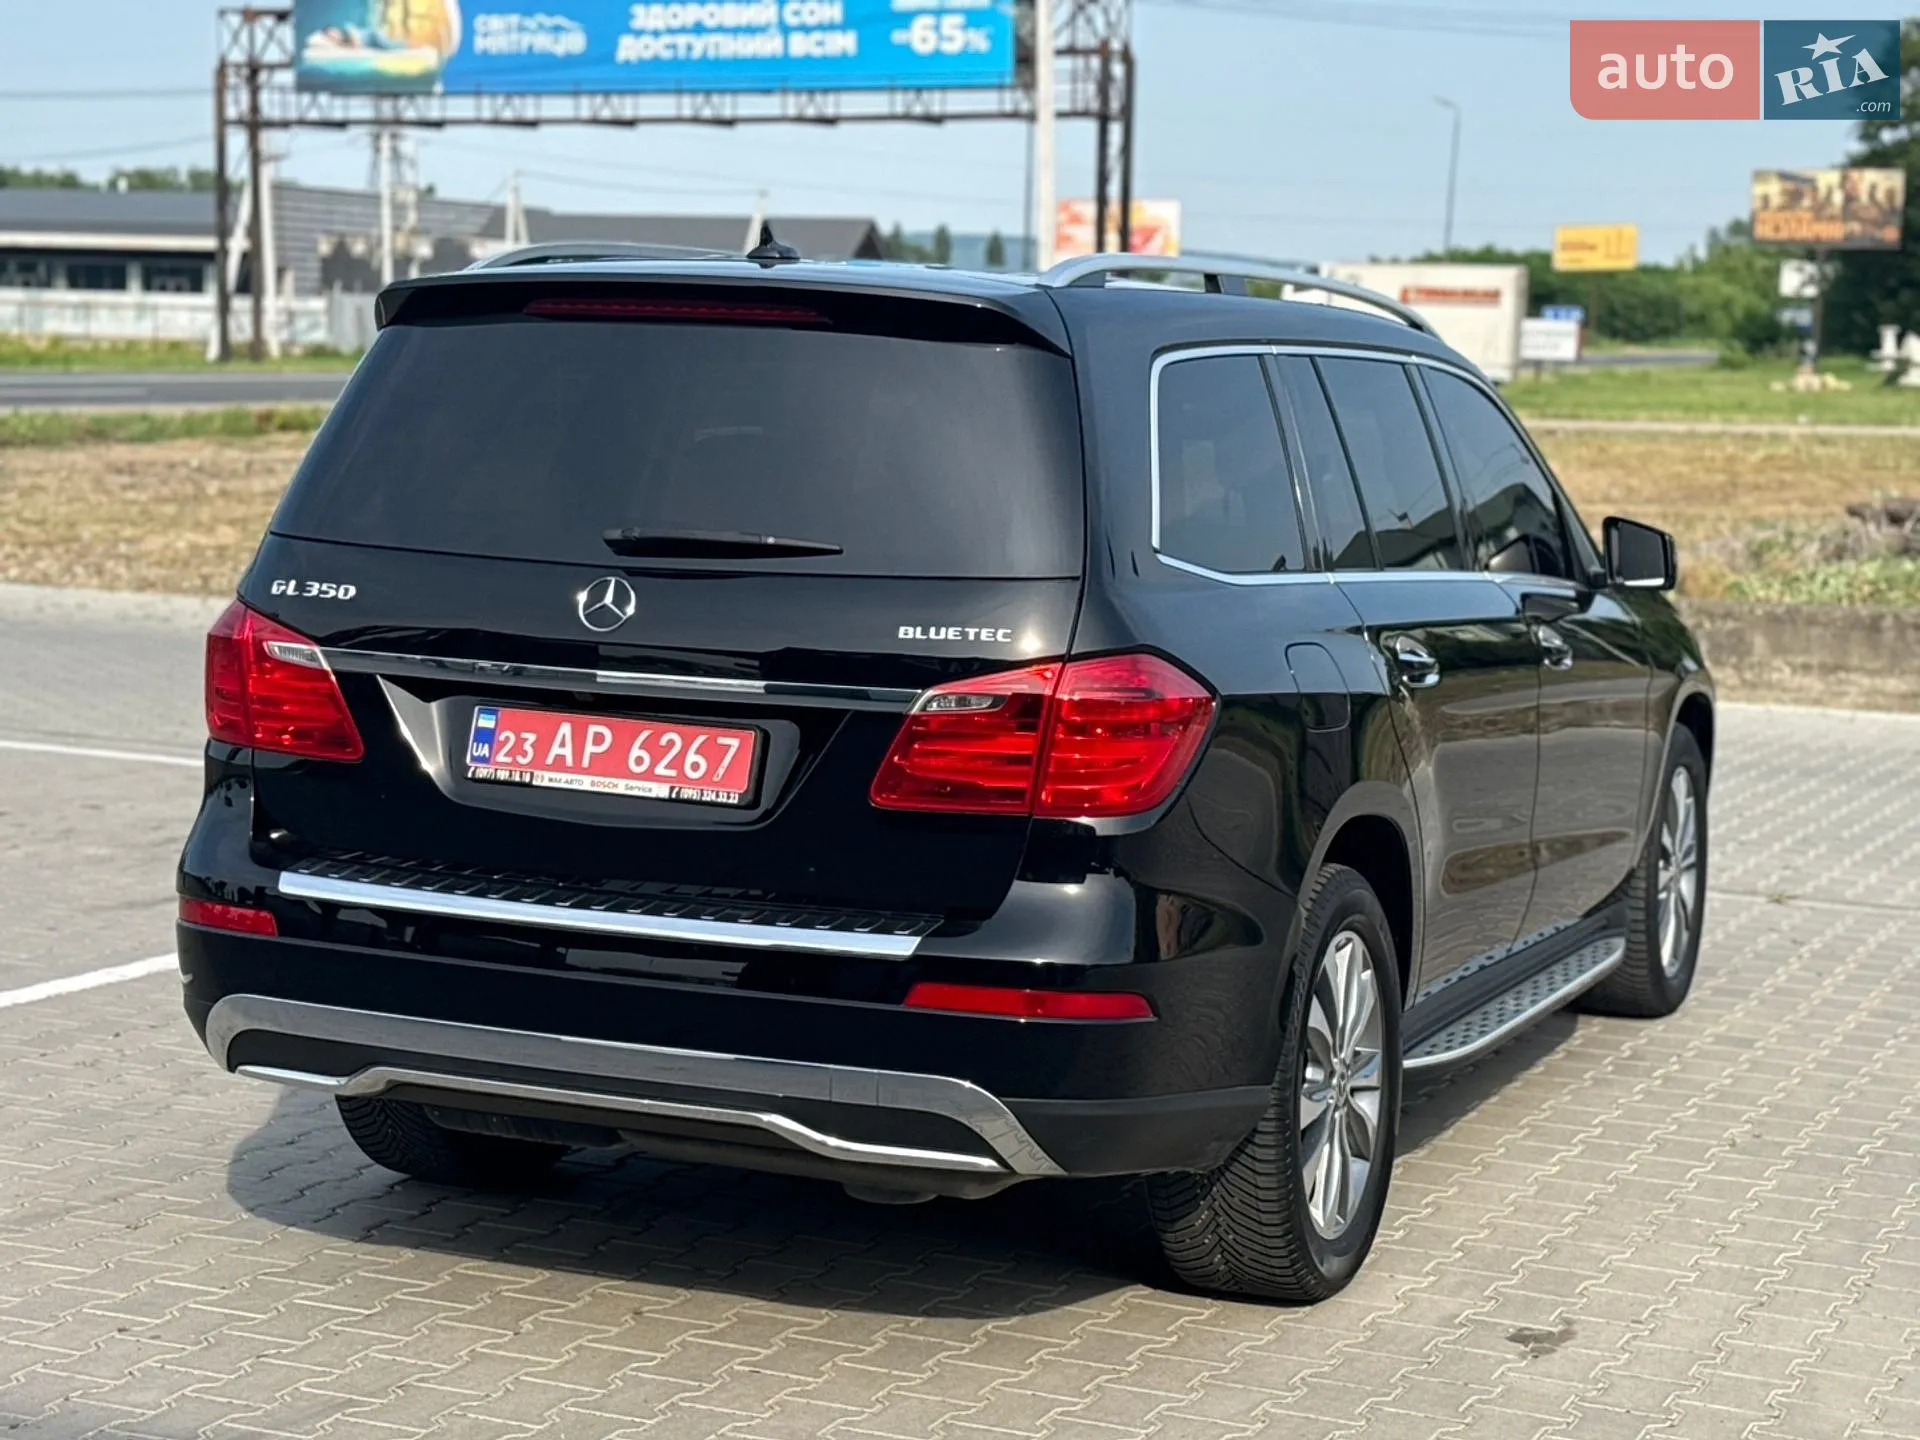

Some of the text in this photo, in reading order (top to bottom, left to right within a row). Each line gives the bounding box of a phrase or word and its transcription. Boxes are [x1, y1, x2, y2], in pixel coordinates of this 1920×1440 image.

[782, 1, 844, 27] СОН
[615, 25, 858, 64] ДОСТУПНИЙ ВСІМ
[898, 626, 1012, 642] BLUETEC
[471, 741, 490, 758] UA
[495, 730, 538, 765] 23
[627, 729, 741, 782] 6267
[590, 780, 653, 793] BOSCH Service
